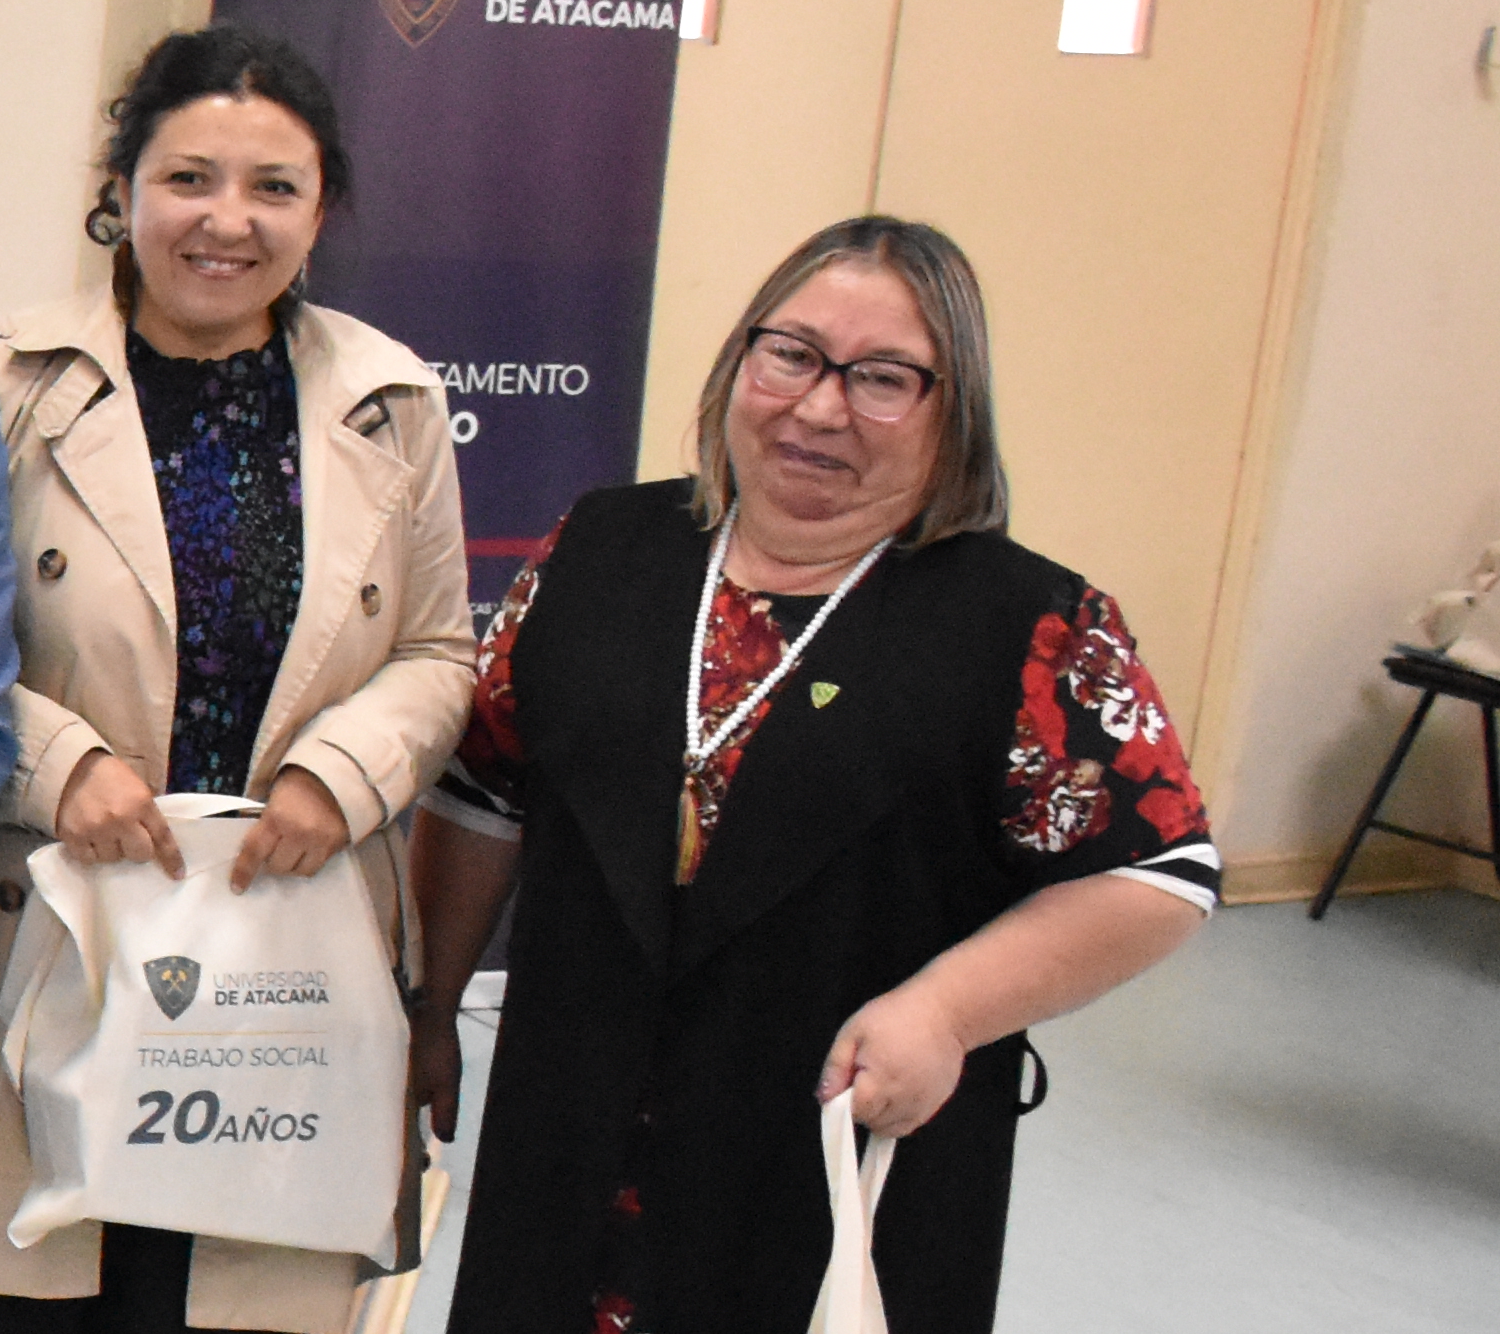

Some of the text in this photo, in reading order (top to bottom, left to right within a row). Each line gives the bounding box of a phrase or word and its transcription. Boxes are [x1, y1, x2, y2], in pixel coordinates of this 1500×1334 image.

[215, 988, 329, 1006] DE ATACAMA
[138, 1045, 328, 1067] TRABAJO SOCIAL
